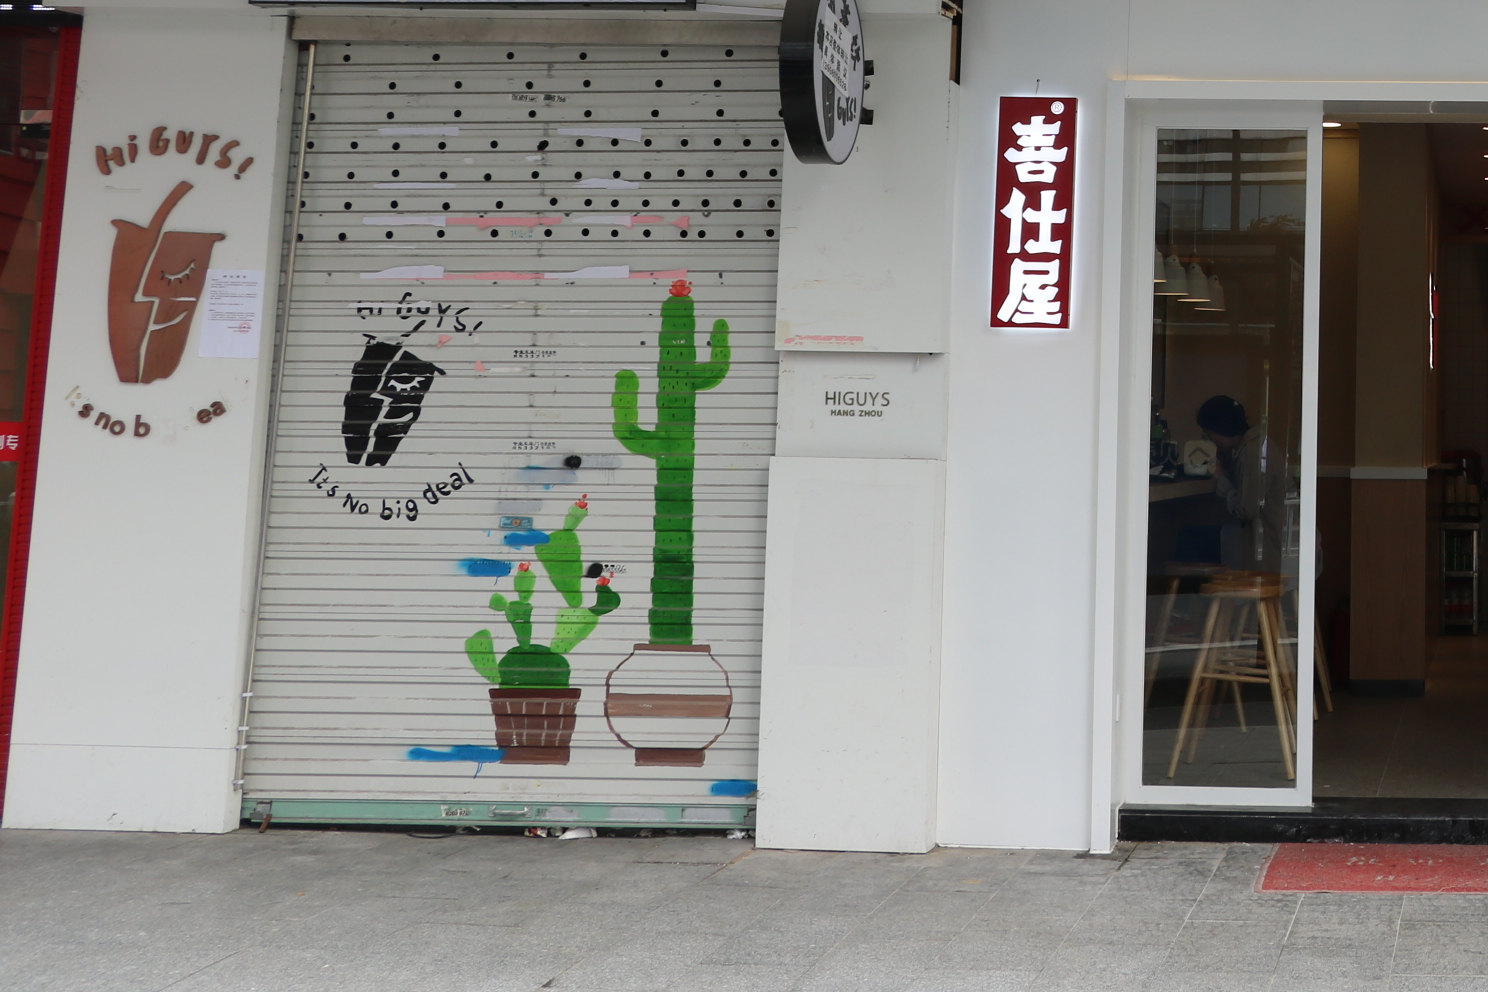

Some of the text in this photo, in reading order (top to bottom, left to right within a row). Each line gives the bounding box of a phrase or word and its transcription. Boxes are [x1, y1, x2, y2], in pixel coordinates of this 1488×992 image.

[95, 135, 138, 175] Hi
[996, 115, 1069, 325] 喜仕屋
[824, 390, 890, 407] HIGUYS
[830, 409, 883, 418] HANG ZHOU
[380, 499, 419, 522] big
[422, 461, 475, 505] deal
